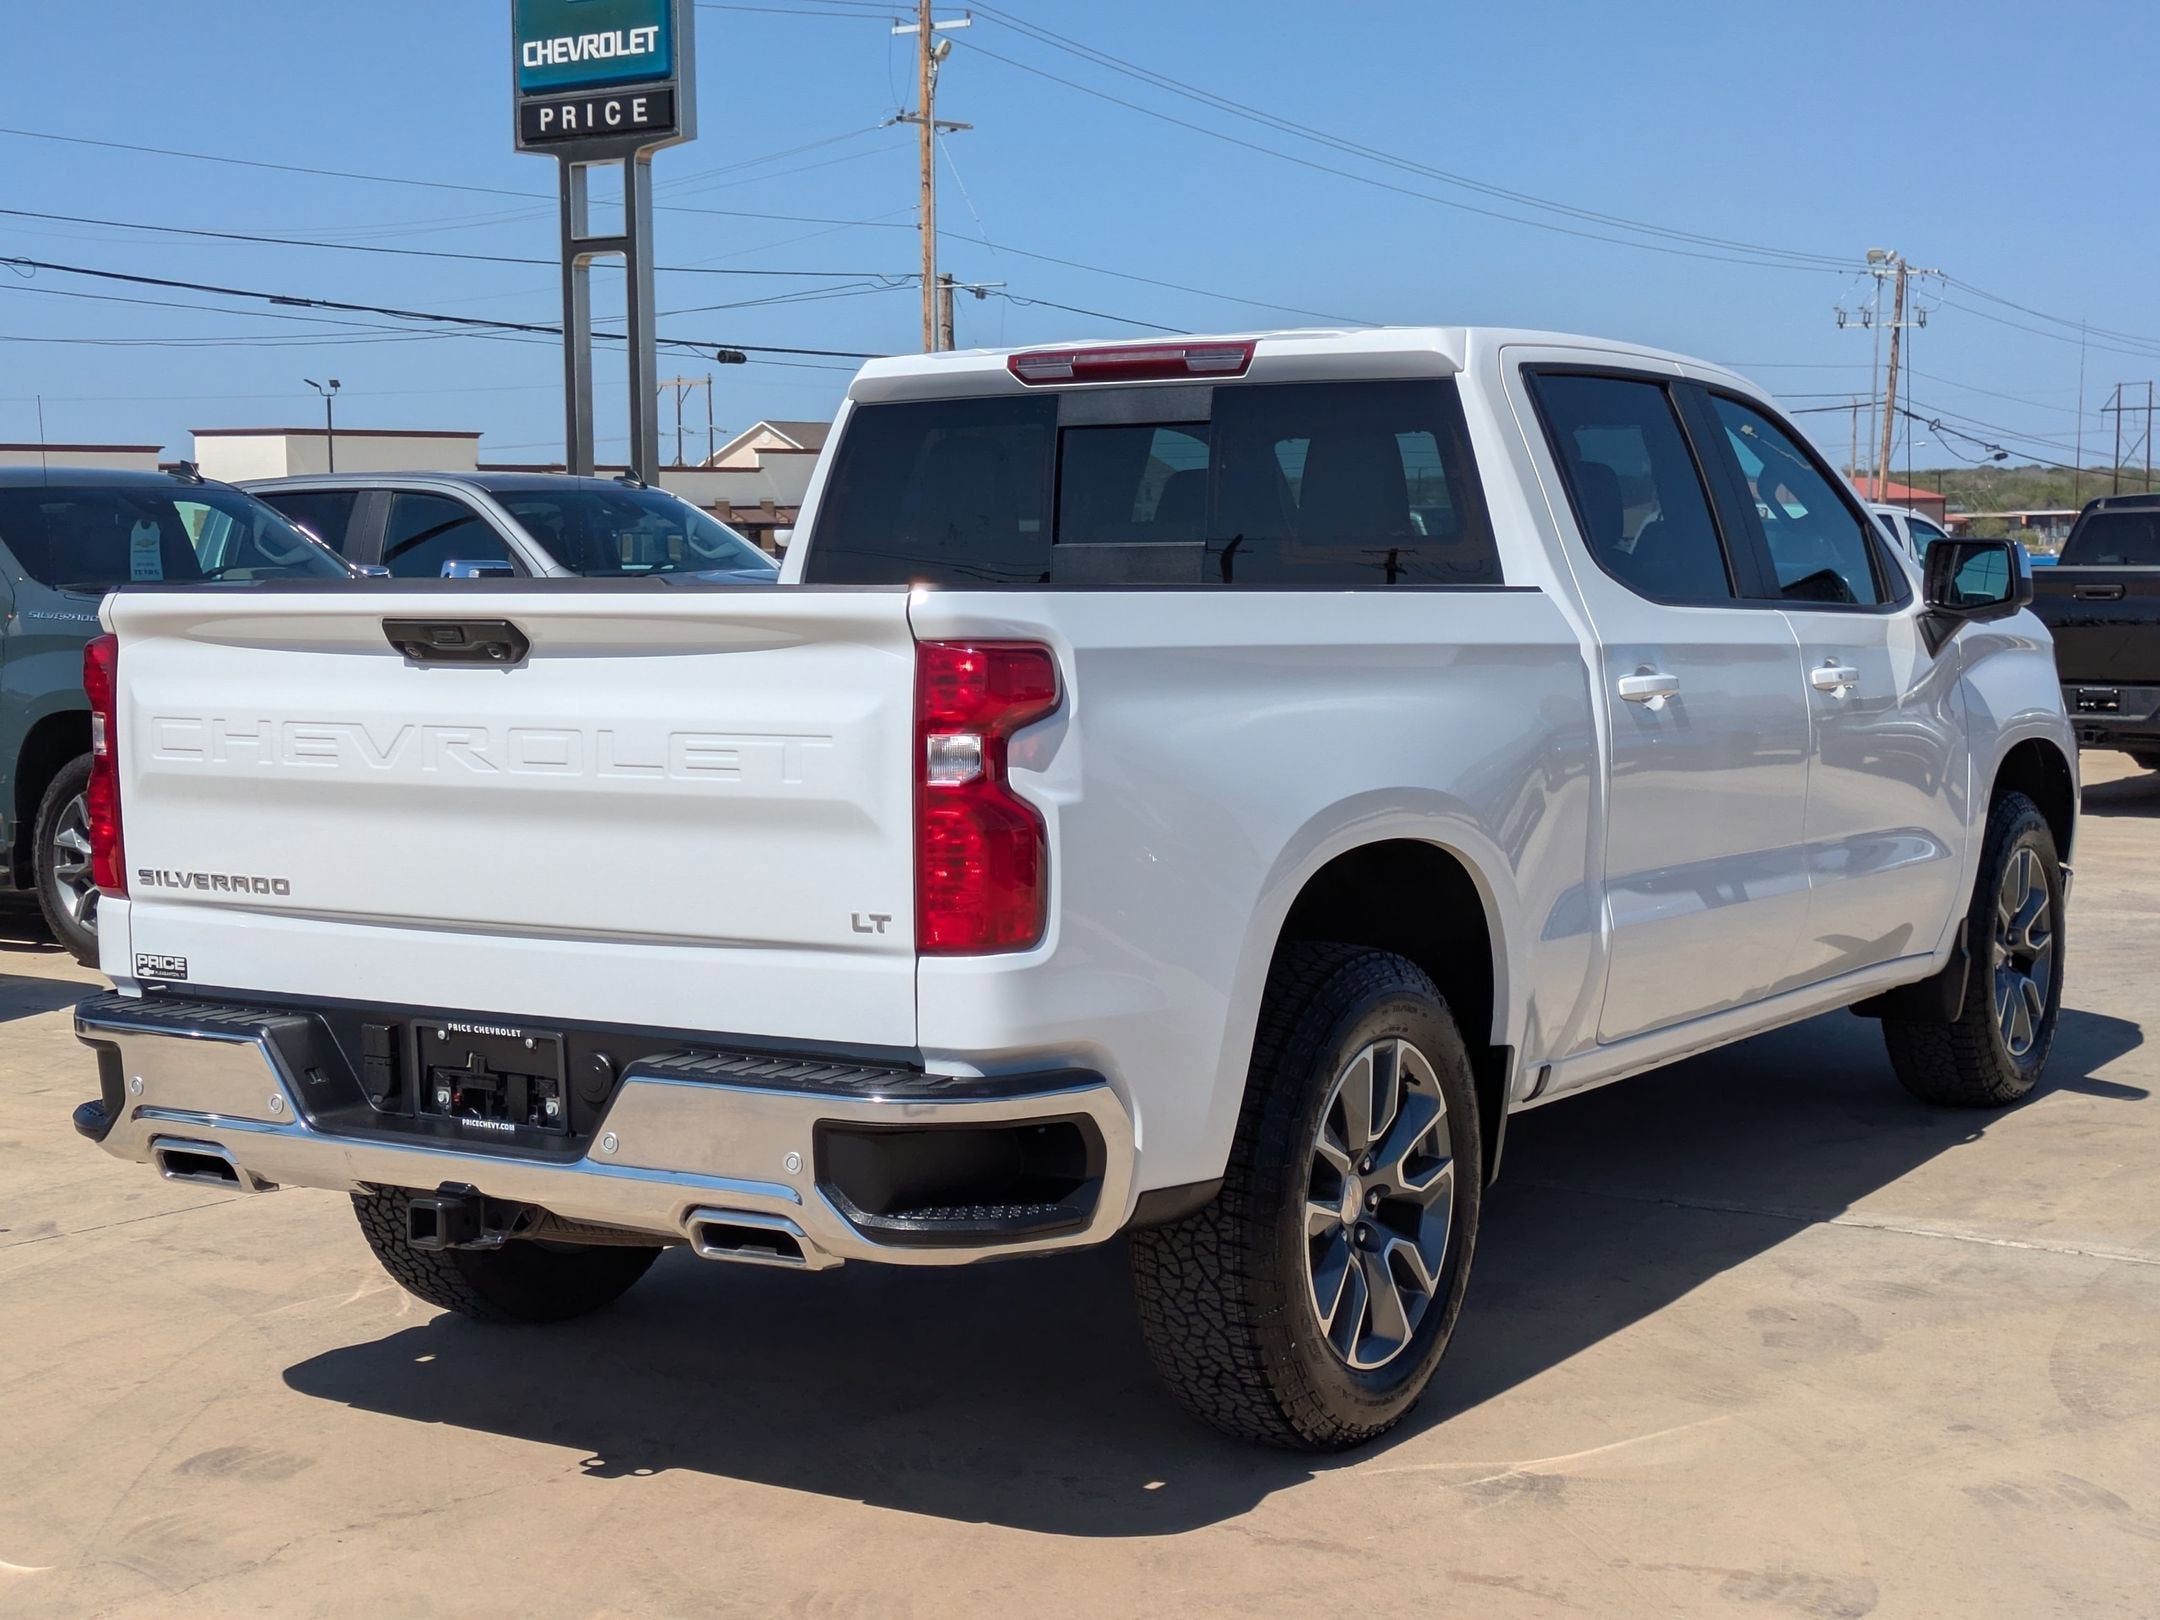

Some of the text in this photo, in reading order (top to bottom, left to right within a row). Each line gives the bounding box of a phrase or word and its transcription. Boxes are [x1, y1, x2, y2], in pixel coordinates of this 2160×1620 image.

[523, 26, 659, 67] CHEVROLET
[540, 98, 648, 132] PRICE
[151, 716, 834, 784] CHEVROLET
[138, 869, 290, 896] SILVERADO
[851, 912, 892, 934] LT
[137, 954, 186, 970] PRICE
[447, 1022, 521, 1038] PRICE CHEVROLET
[462, 1118, 515, 1132] PRICECHEVY.COM
